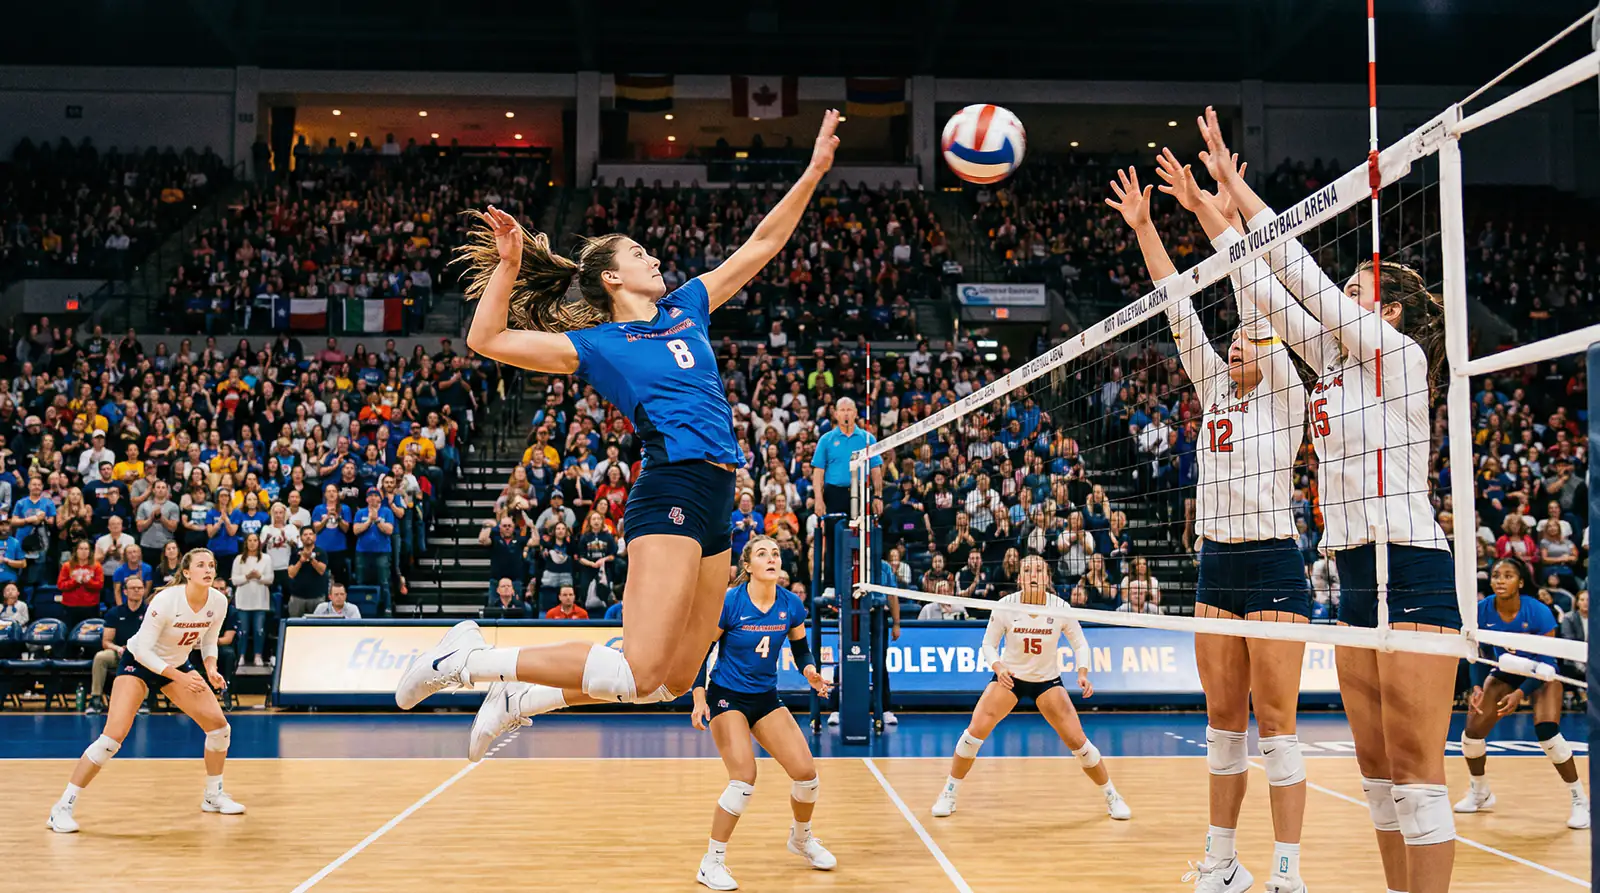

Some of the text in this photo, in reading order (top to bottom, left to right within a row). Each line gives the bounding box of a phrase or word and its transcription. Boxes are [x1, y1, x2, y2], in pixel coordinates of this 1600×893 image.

[1247, 207, 1303, 252] VOLLEYBALL
[1304, 183, 1339, 221] ARENA
[666, 339, 696, 370] 8
[1309, 397, 1331, 439] 15
[1207, 418, 1234, 453] 12
[177, 631, 200, 646] 12
[755, 635, 770, 658] 4
[1023, 637, 1042, 655] 15
[1122, 646, 1177, 673] ANE
